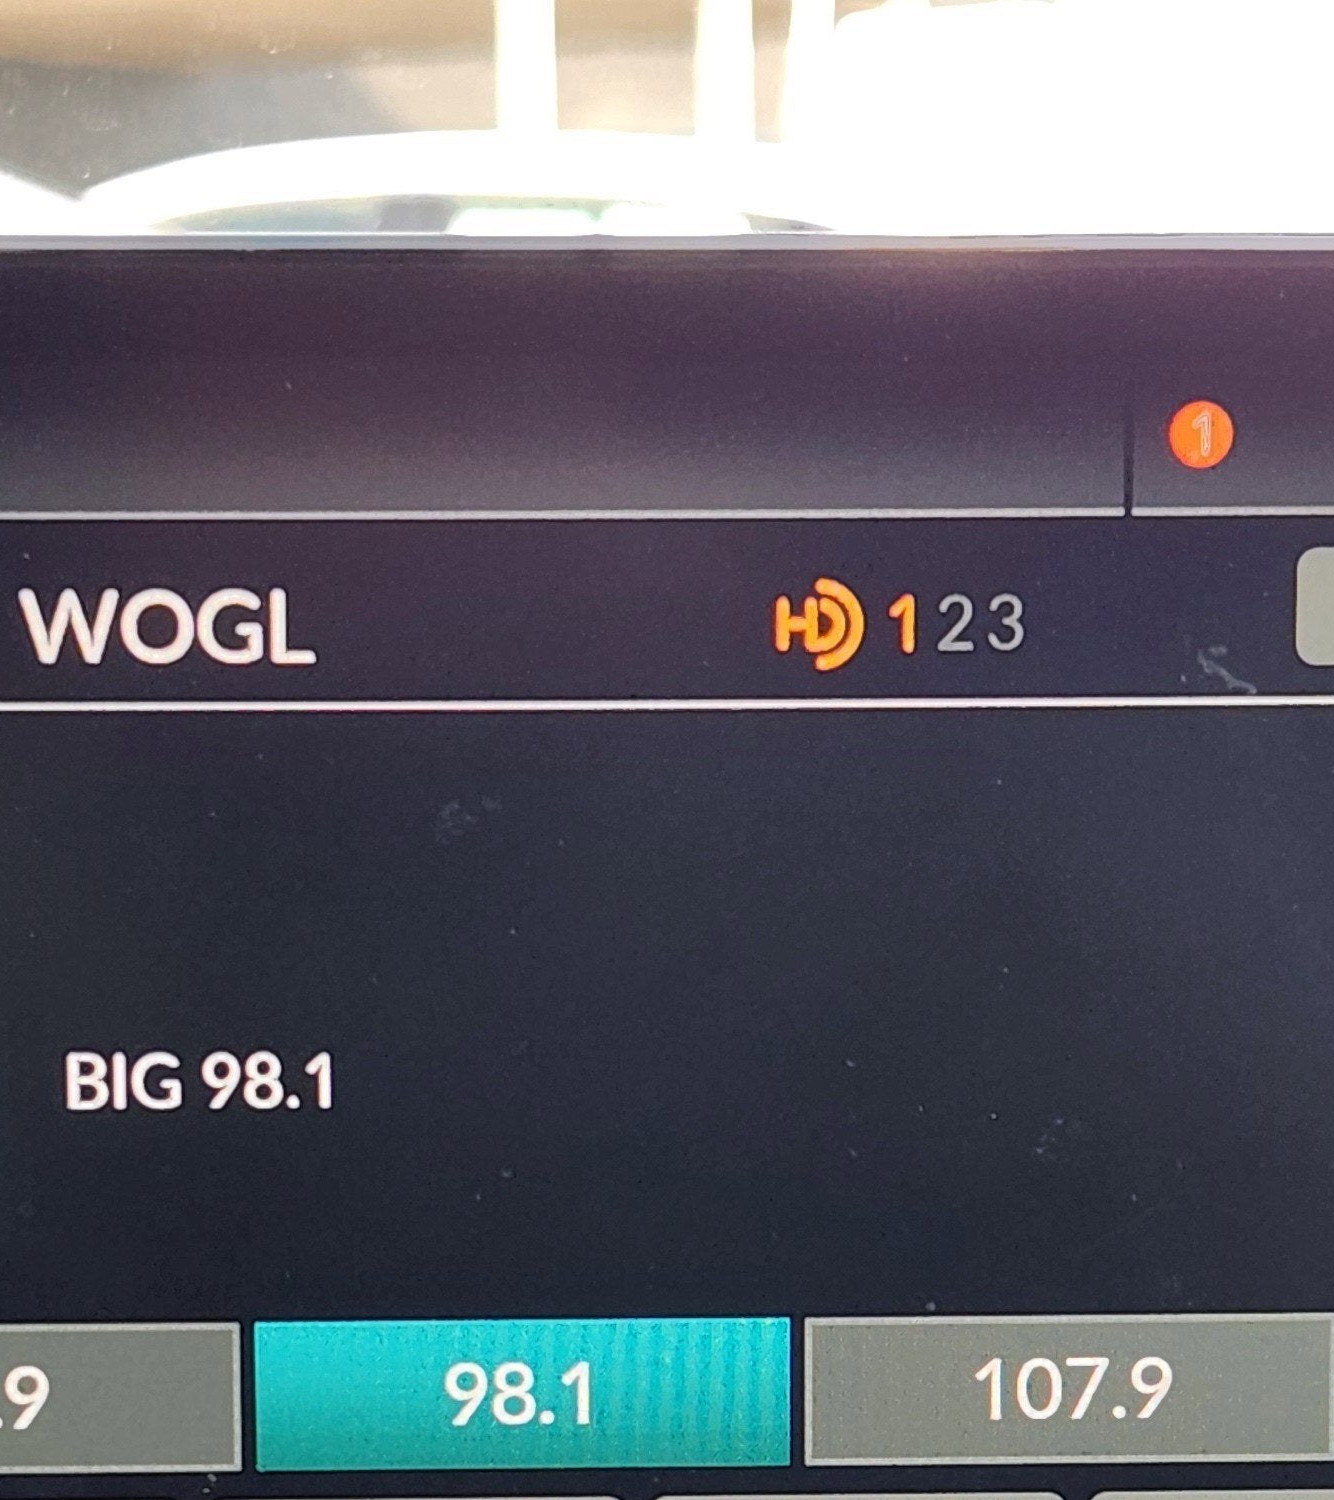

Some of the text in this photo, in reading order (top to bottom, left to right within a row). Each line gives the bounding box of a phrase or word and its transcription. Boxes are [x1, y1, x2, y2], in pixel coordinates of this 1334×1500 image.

[17, 587, 318, 665] WOGL
[67, 1051, 335, 1111] BIG 98.1
[443, 1360, 594, 1427] 98.1
[974, 1355, 1175, 1421] 107.9
